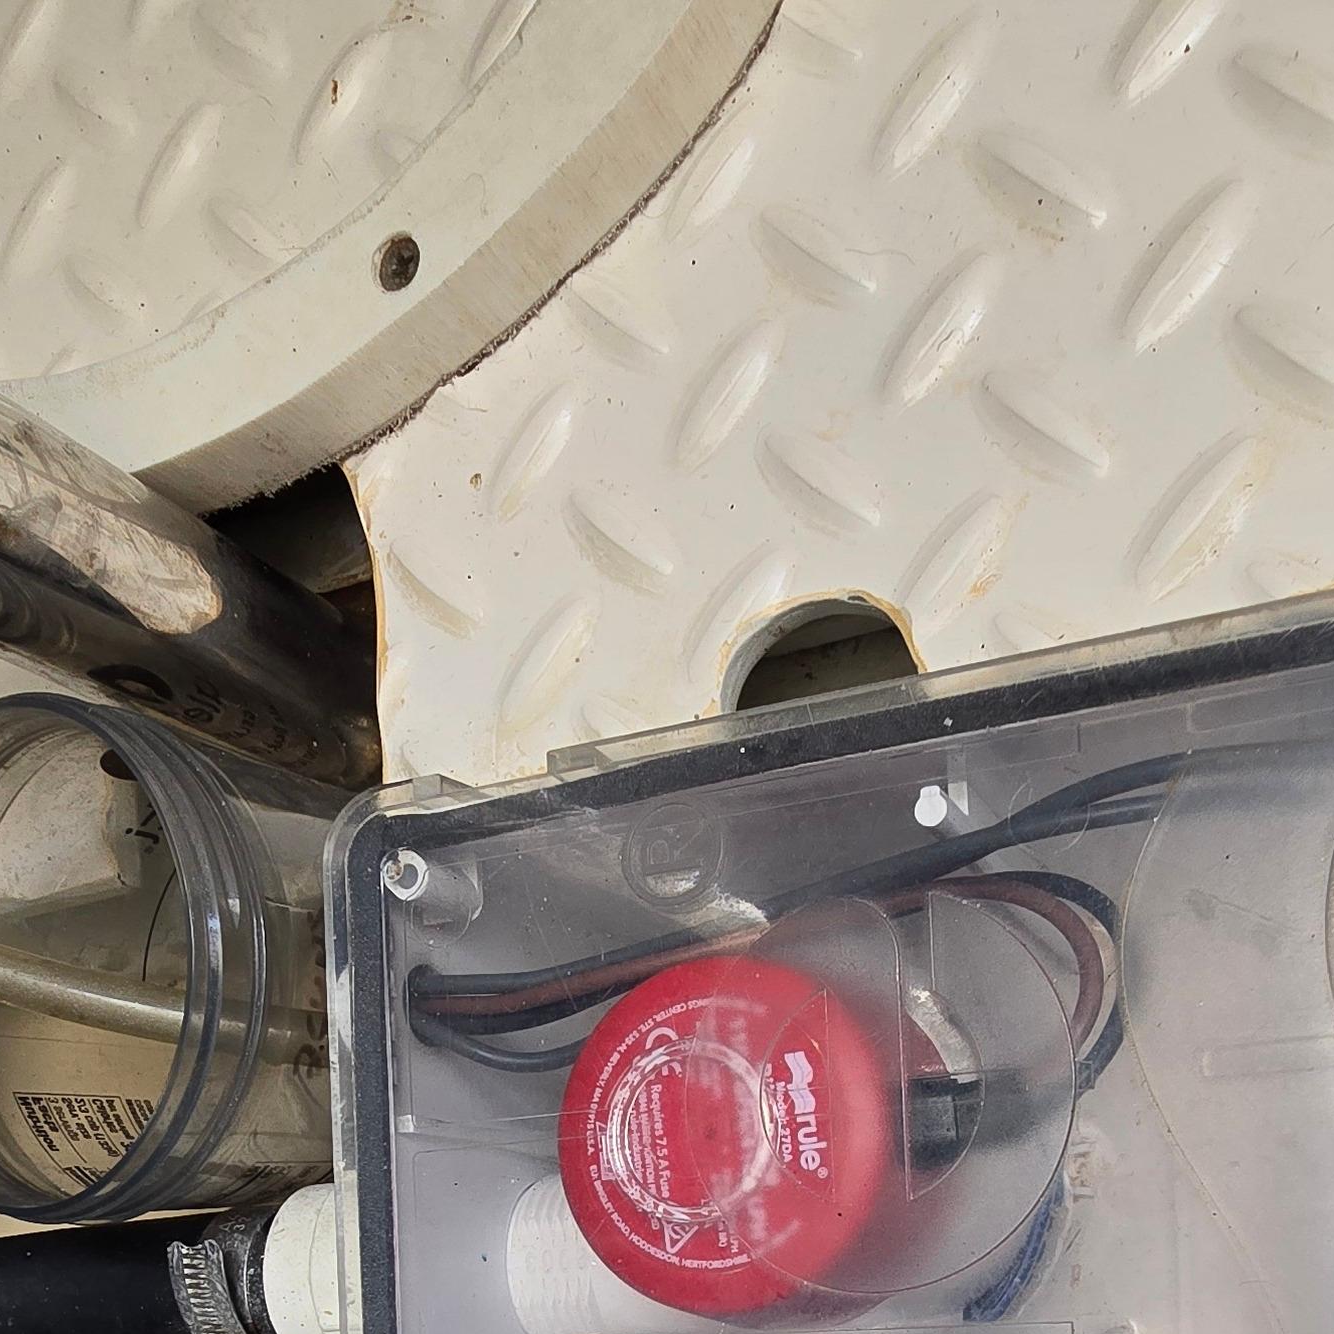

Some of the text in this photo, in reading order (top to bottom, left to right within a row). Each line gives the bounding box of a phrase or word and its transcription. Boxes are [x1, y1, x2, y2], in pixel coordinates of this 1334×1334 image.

[650, 1084, 664, 1136] Requires
[655, 1137, 667, 1157] 7.5
[660, 1170, 671, 1198] Fuse
